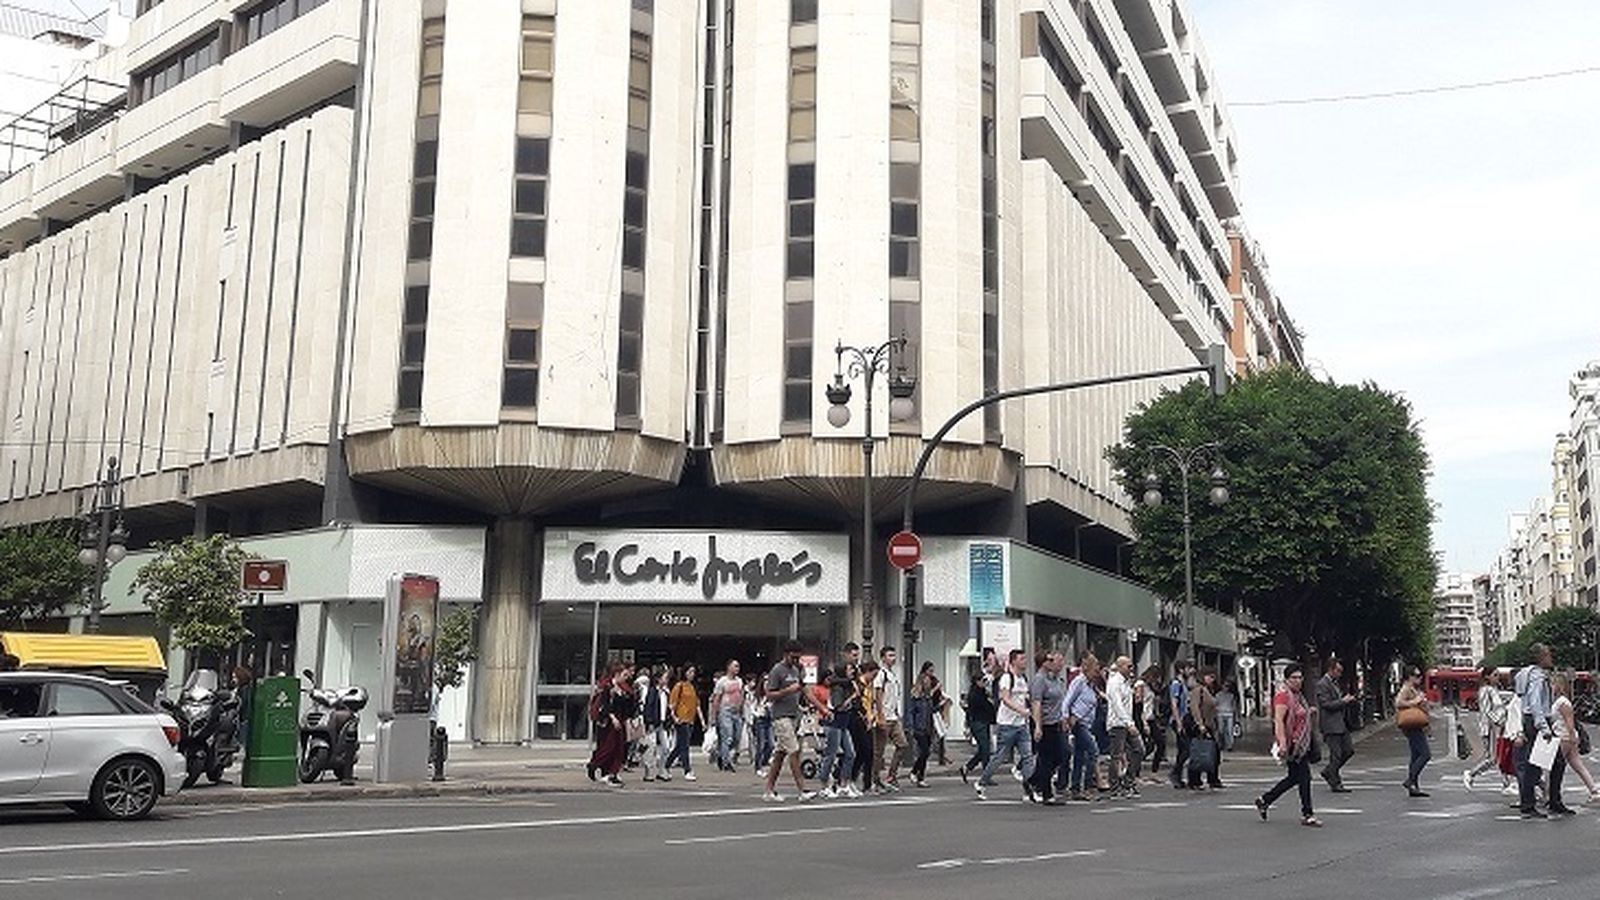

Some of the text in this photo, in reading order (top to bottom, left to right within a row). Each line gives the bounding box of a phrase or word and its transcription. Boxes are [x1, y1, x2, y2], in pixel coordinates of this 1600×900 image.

[574, 535, 822, 600] El Corte Inglés
